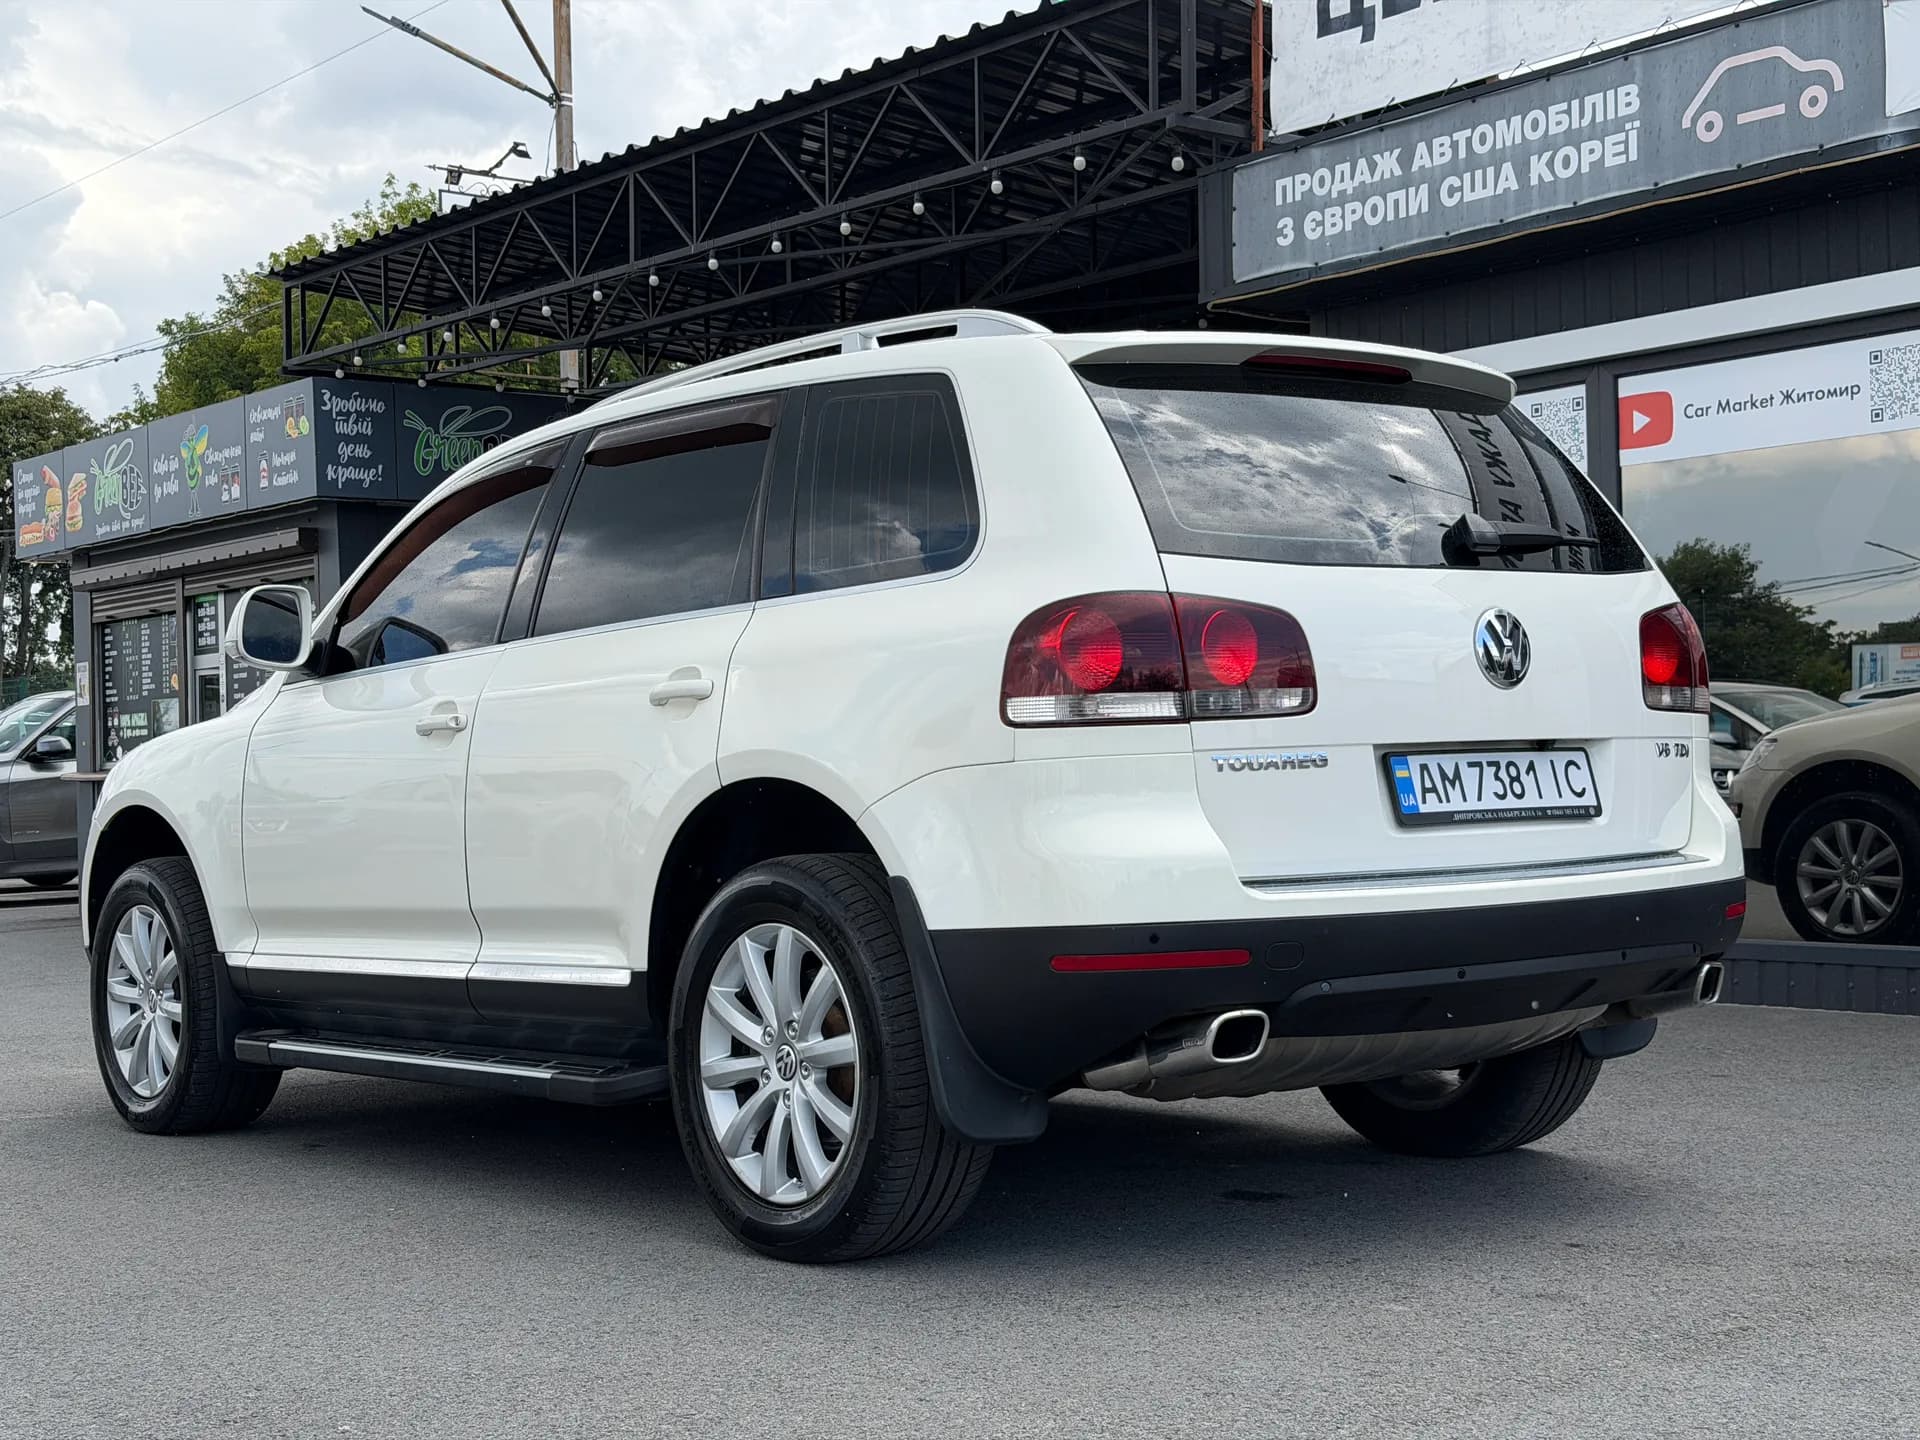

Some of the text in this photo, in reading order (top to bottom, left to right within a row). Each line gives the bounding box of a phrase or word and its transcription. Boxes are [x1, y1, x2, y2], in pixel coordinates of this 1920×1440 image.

[1275, 83, 1641, 206] ПРОДАЖ АВТОМОБІЛІВ
[1275, 119, 1641, 247] З ЄВРОПИ США КОРЕЇ
[321, 389, 386, 419] Зробимо
[1683, 383, 1862, 419] Car Market Житомир
[335, 413, 373, 437] твій
[337, 441, 372, 464] день
[325, 464, 383, 489] краще!
[1655, 742, 1671, 757] V6
[1211, 751, 1329, 773] TOUAREG
[1401, 794, 1417, 807] UA
